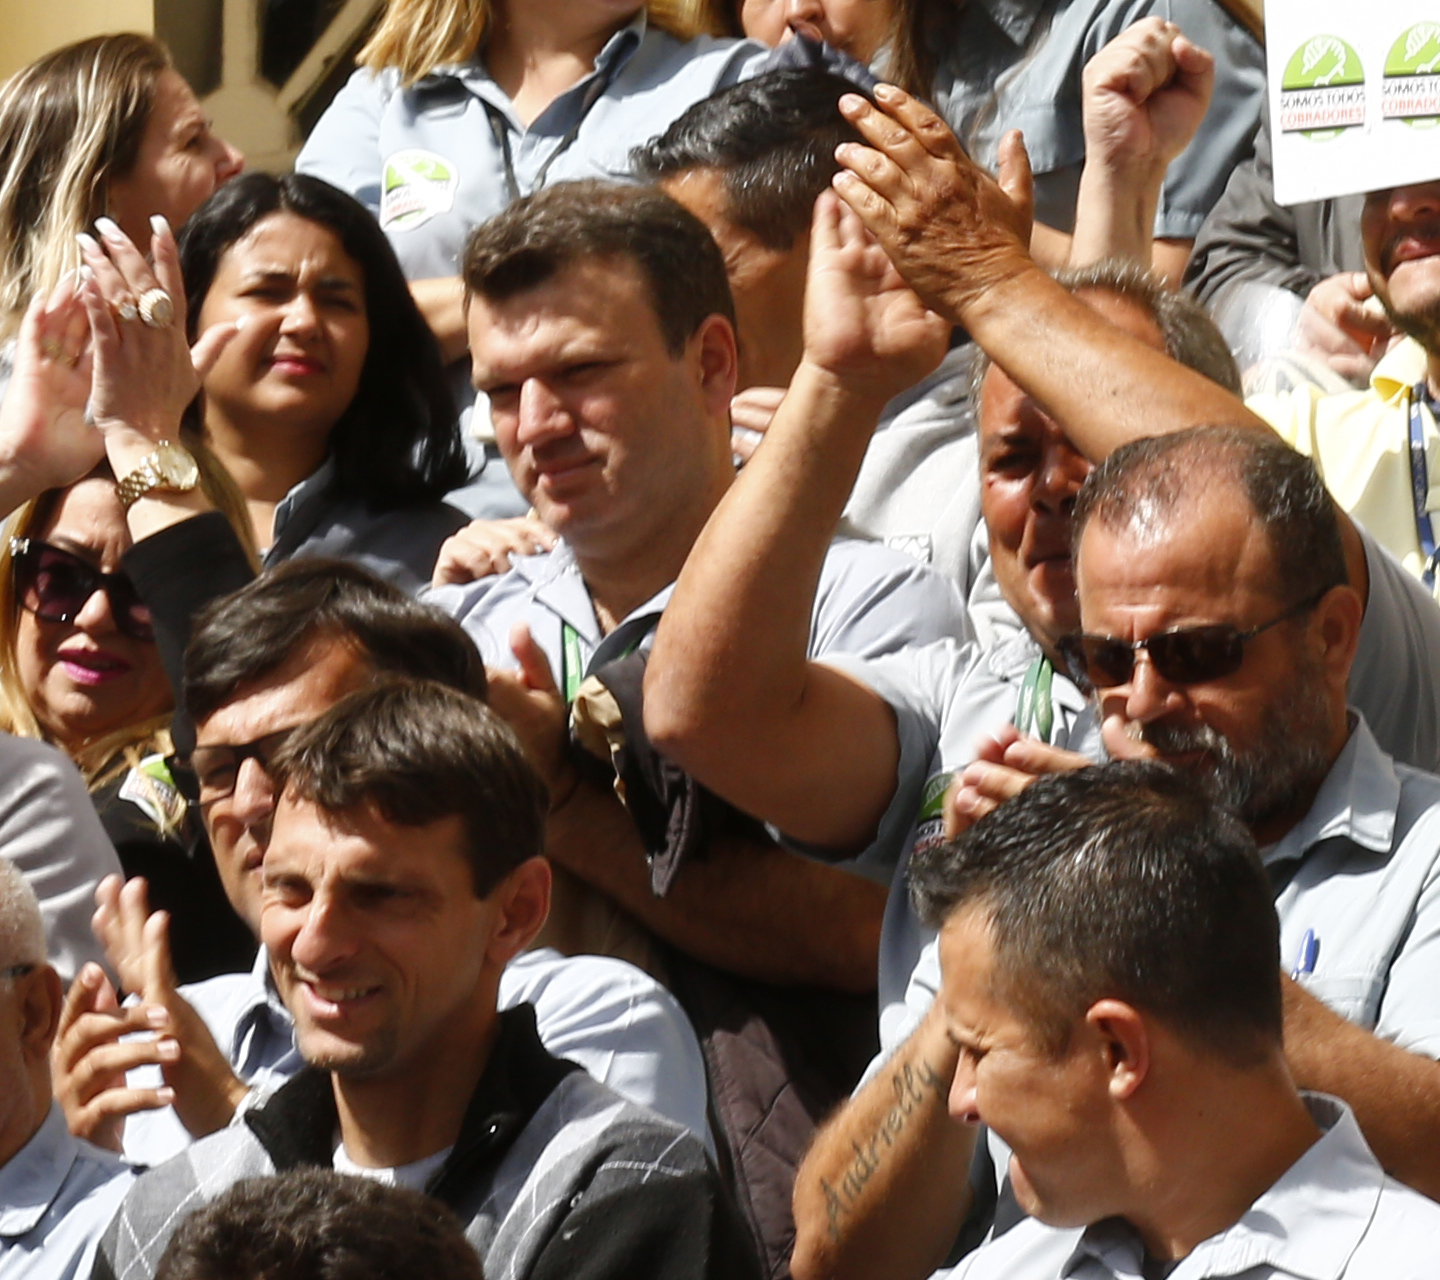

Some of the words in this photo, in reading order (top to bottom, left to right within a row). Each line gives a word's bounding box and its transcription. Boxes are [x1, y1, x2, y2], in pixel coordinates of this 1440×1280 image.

[1382, 80, 1425, 96] SOMOS
[1280, 95, 1323, 110] SOMOS
[1326, 90, 1365, 107] TODOS
